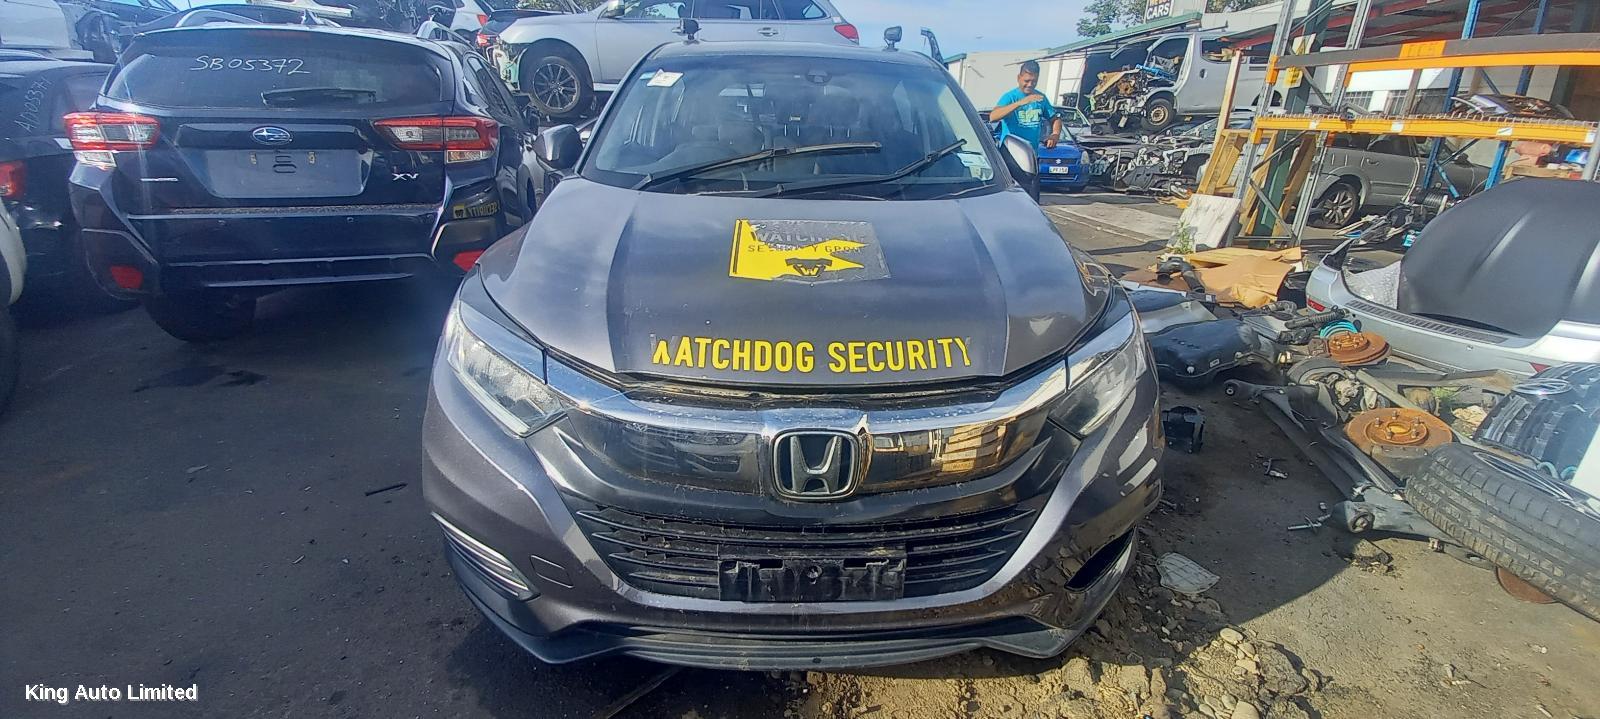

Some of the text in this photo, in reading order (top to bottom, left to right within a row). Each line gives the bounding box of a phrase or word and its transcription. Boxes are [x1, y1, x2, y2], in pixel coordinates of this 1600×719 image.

[1147, 3, 1170, 19] CARS
[190, 56, 311, 75] SB05372
[392, 173, 419, 181] XV
[828, 336, 971, 373] SECURITY
